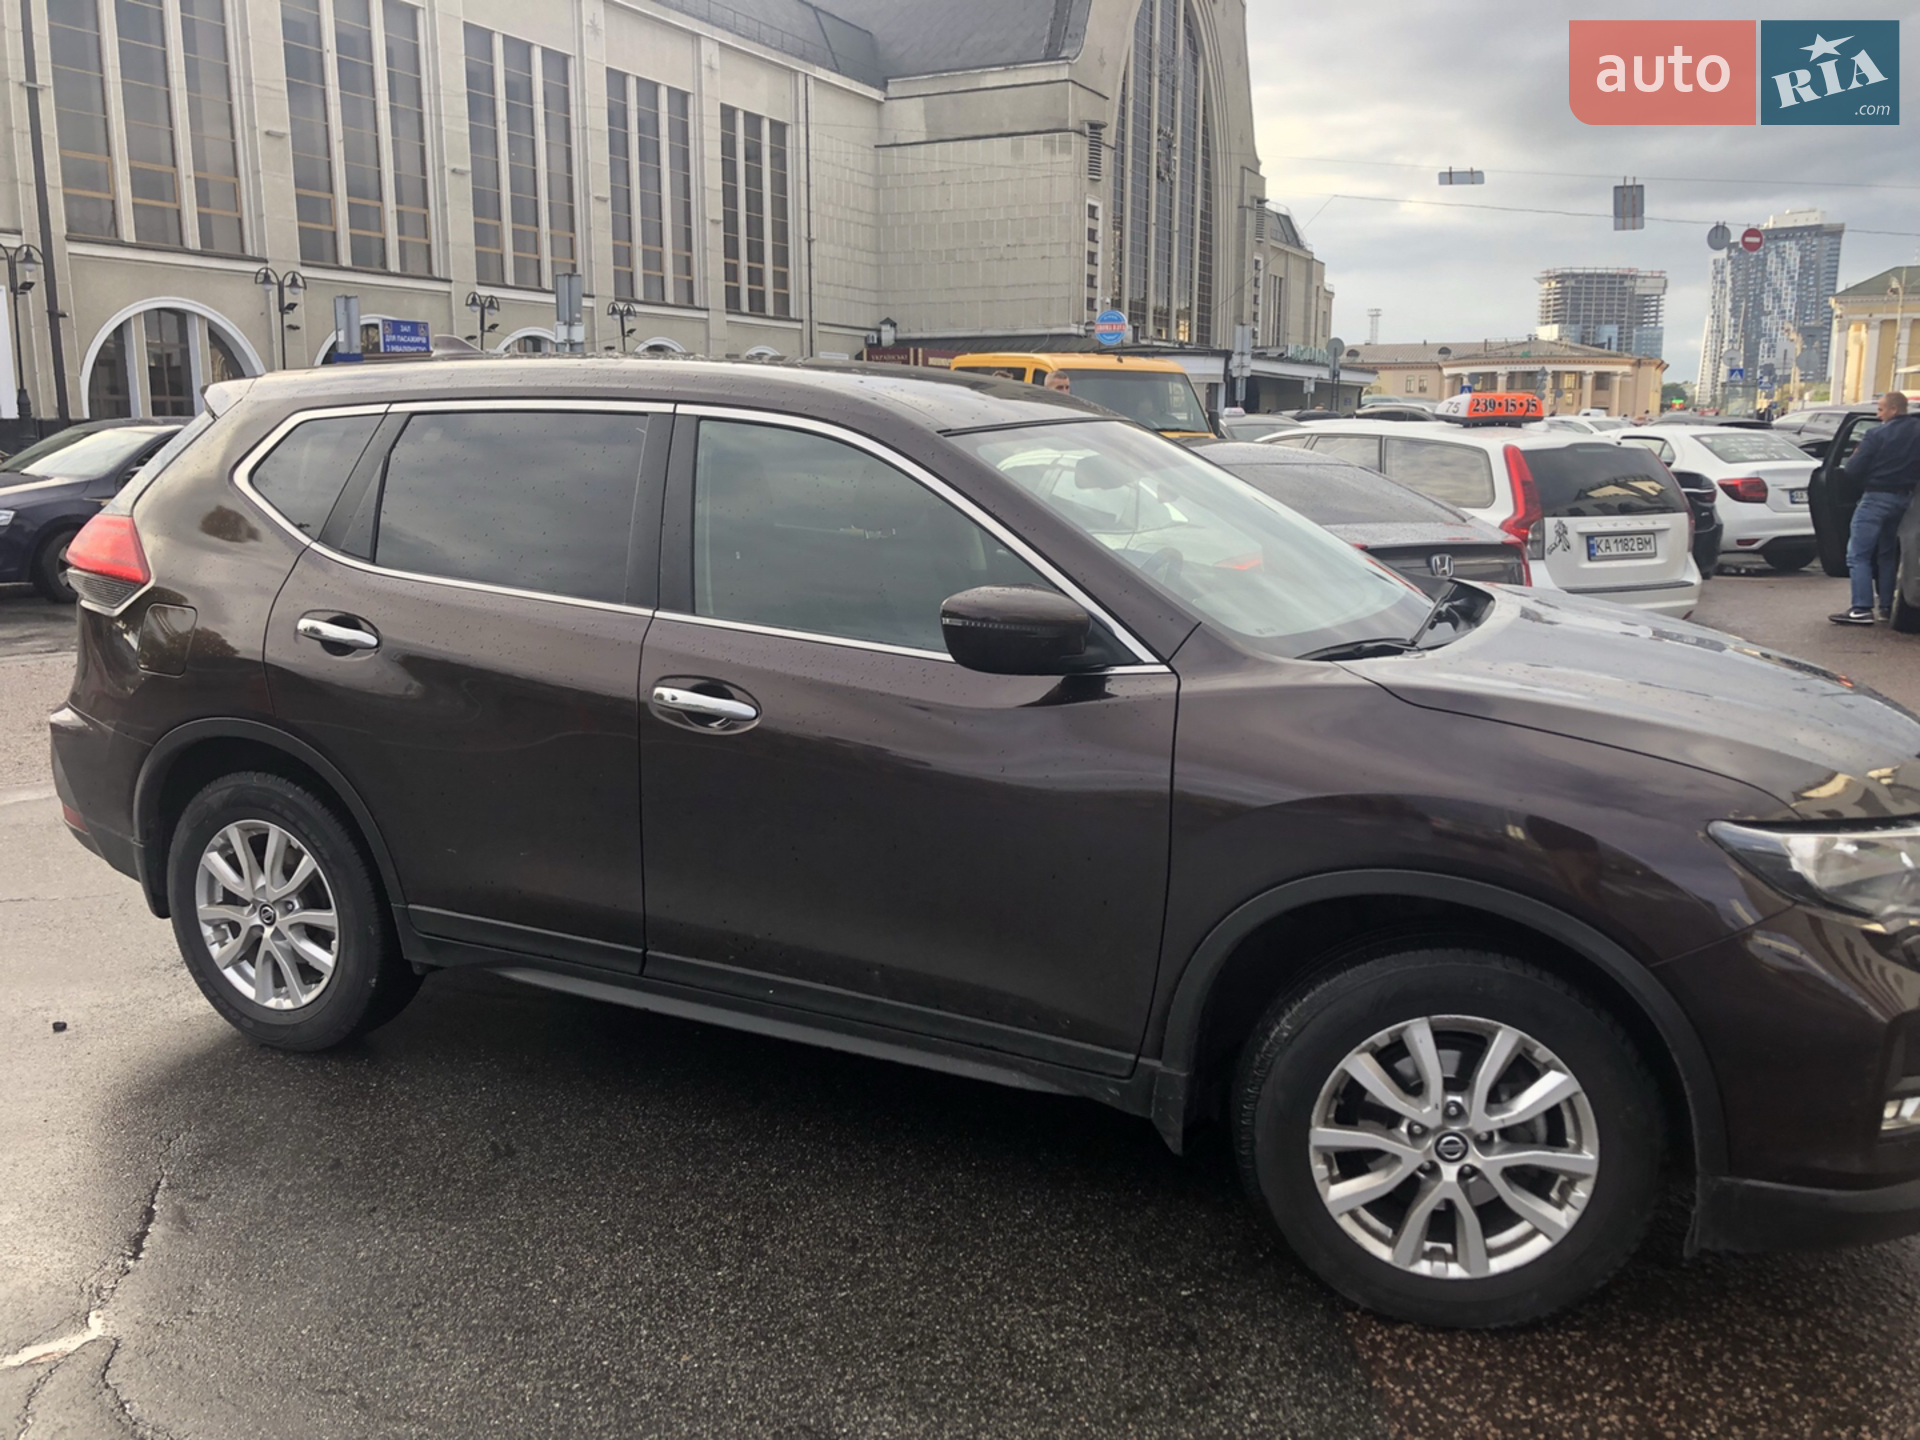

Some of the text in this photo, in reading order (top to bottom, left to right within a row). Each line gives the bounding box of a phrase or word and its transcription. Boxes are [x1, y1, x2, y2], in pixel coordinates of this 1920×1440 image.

[385, 334, 427, 343] ДЛЯ ПАСАЖИРІВ
[1445, 401, 1461, 414] 75
